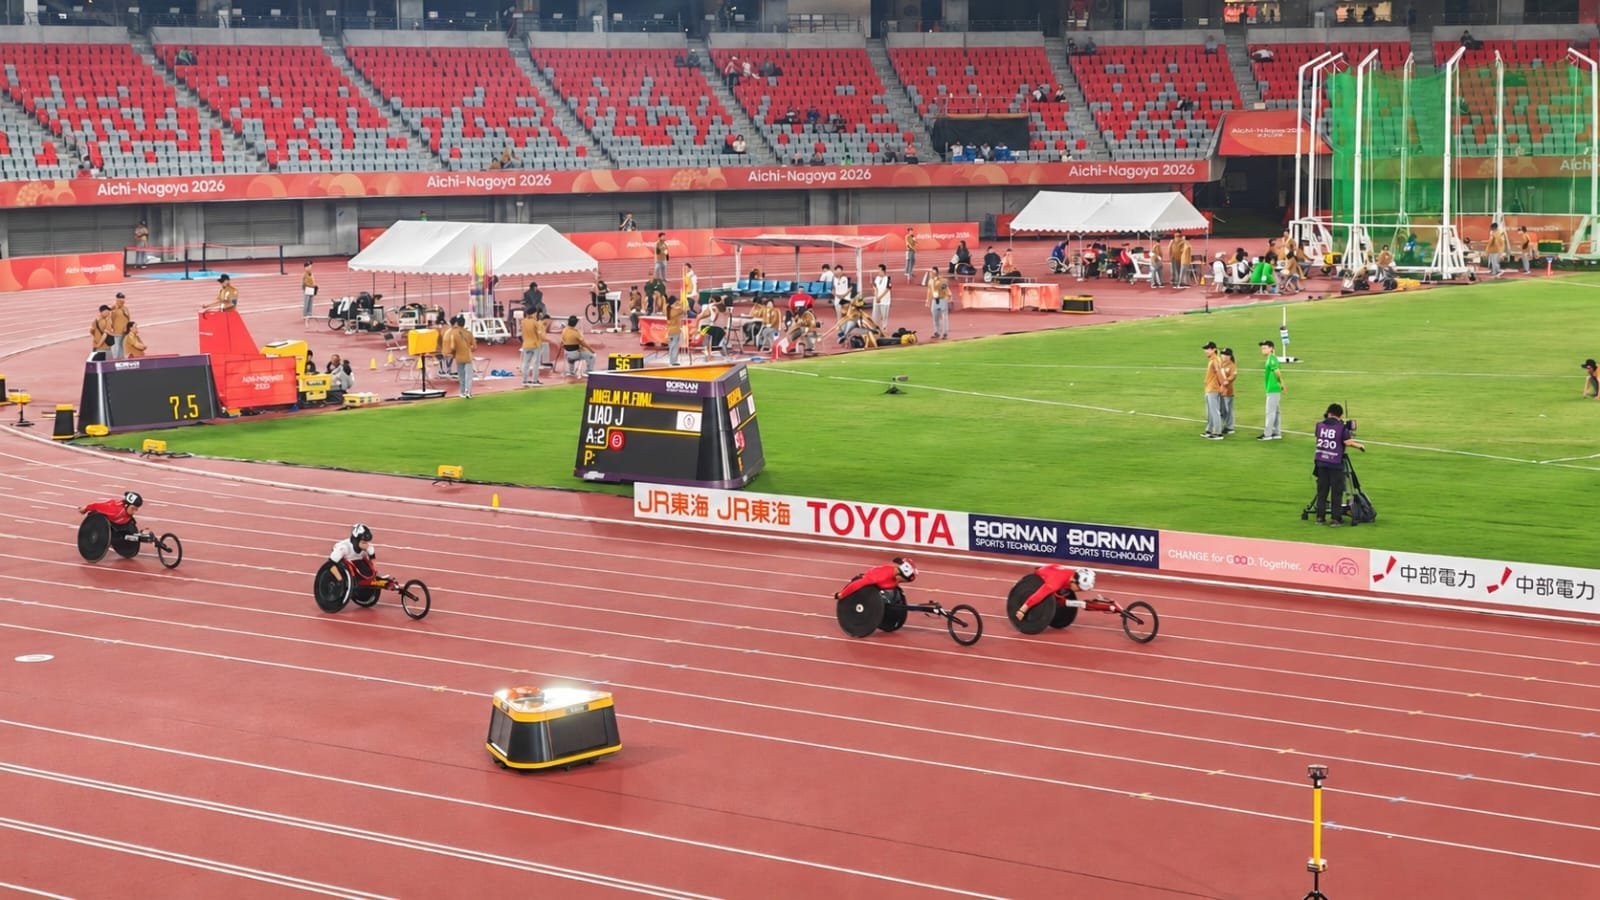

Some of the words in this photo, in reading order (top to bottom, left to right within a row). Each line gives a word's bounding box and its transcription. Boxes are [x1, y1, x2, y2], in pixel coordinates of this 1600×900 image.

[427, 174, 516, 190] Aichi-Nagoya
[520, 174, 552, 187] 2026
[748, 169, 836, 184] Aichi-Nagoya
[840, 169, 871, 181] 2026
[1069, 165, 1158, 179] Aichi-Nagoya
[1163, 164, 1195, 176] 2026
[97, 180, 189, 198] Aichi-Nagoya
[192, 179, 225, 193] 2026
[169, 394, 199, 420] 7.5
[587, 404, 612, 424] LIAO
[614, 406, 625, 425] J
[585, 428, 605, 444] A:2
[1320, 428, 1336, 439] HB
[584, 450, 595, 466] P:
[638, 489, 709, 517] JR東海
[717, 495, 791, 525] JR東海
[807, 501, 955, 547] TOYOTA
[973, 520, 1057, 543] BORNAN
[975, 538, 1005, 549] SPORTS
[1006, 541, 1057, 553] TECHNOLOGY
[1067, 529, 1155, 552] BORNAN
[1069, 547, 1099, 558] SPORTS
[1101, 550, 1154, 562] TECHNOLOGY
[1168, 549, 1208, 561] CHANGE
[1211, 554, 1224, 563] for
[1258, 557, 1301, 571] Together.
[1400, 564, 1476, 589] 中部電力
[1516, 575, 1595, 601] 中部電力
